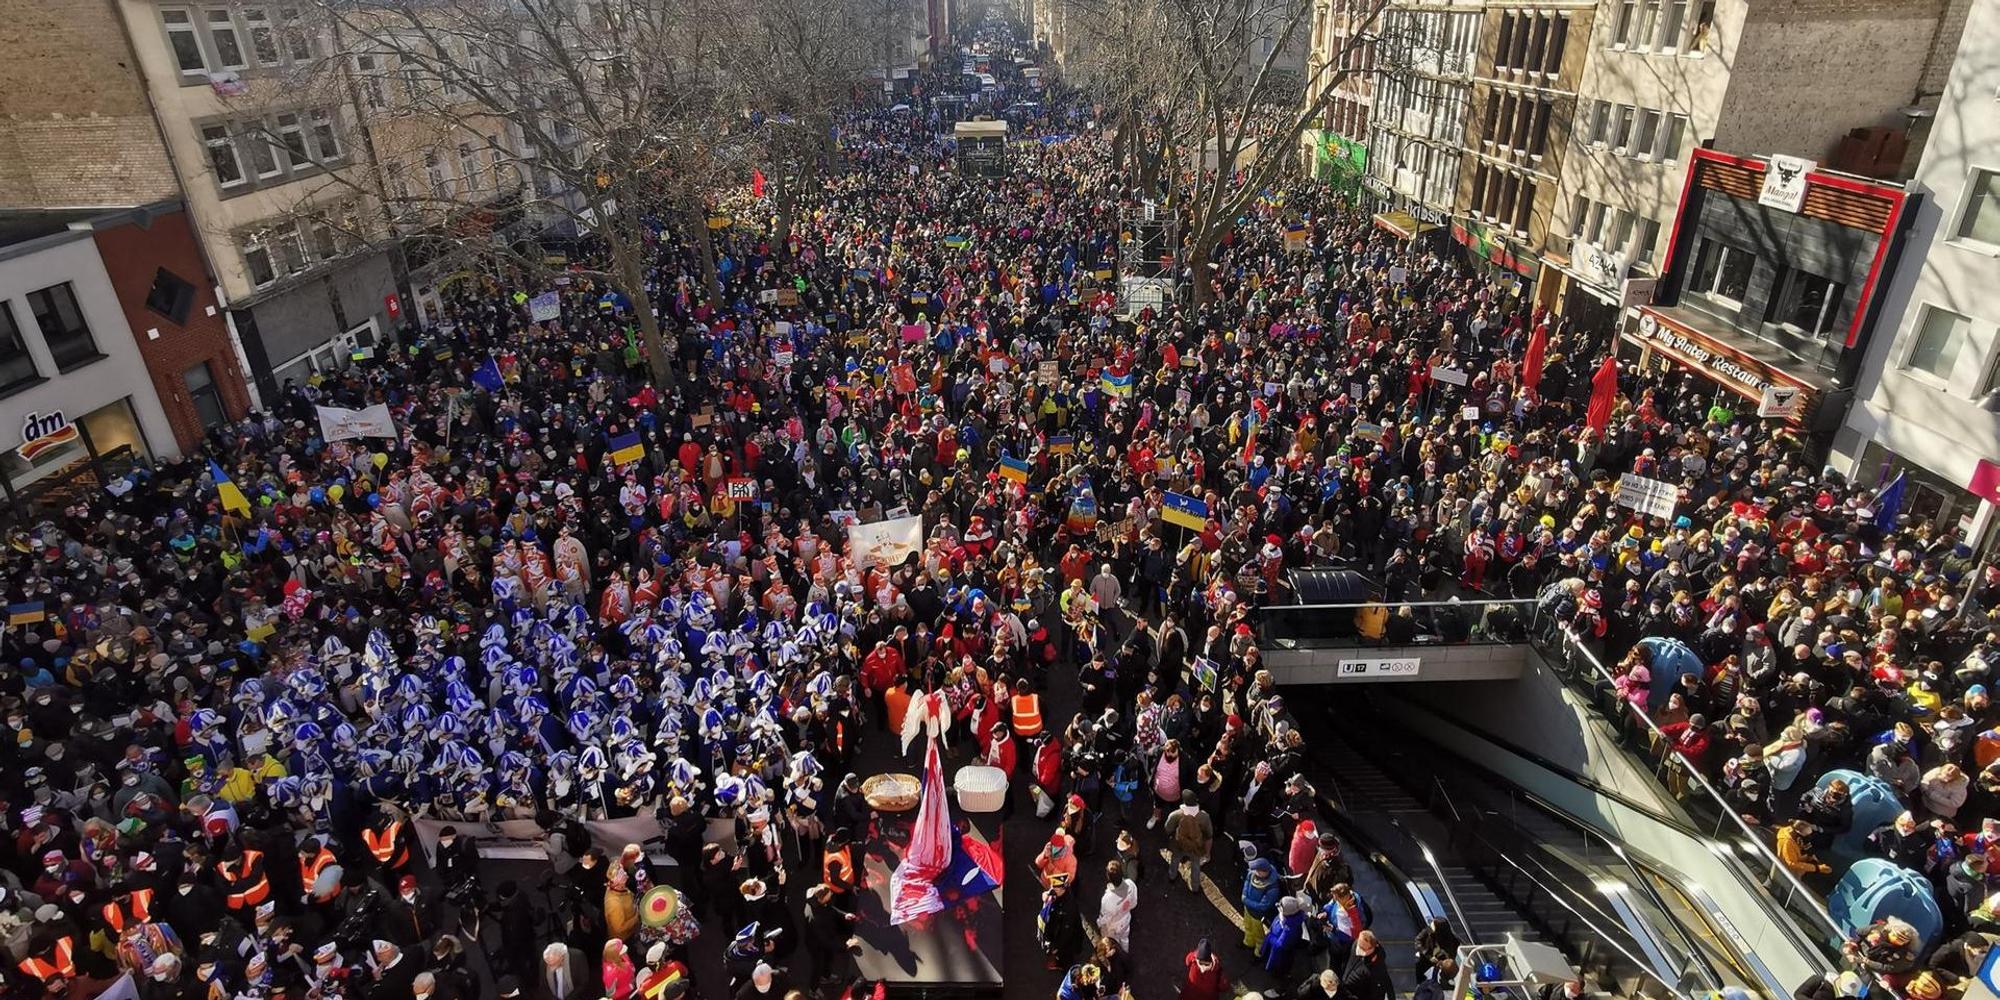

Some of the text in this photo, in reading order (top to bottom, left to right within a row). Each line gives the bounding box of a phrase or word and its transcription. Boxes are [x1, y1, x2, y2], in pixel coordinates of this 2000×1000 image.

[1765, 185, 1798, 200] Mangal
[1409, 204, 1447, 227] KIOSK
[1657, 326, 1773, 391] My Antep Restaura
[25, 411, 65, 441] dm
[1343, 664, 1366, 672] U 17
